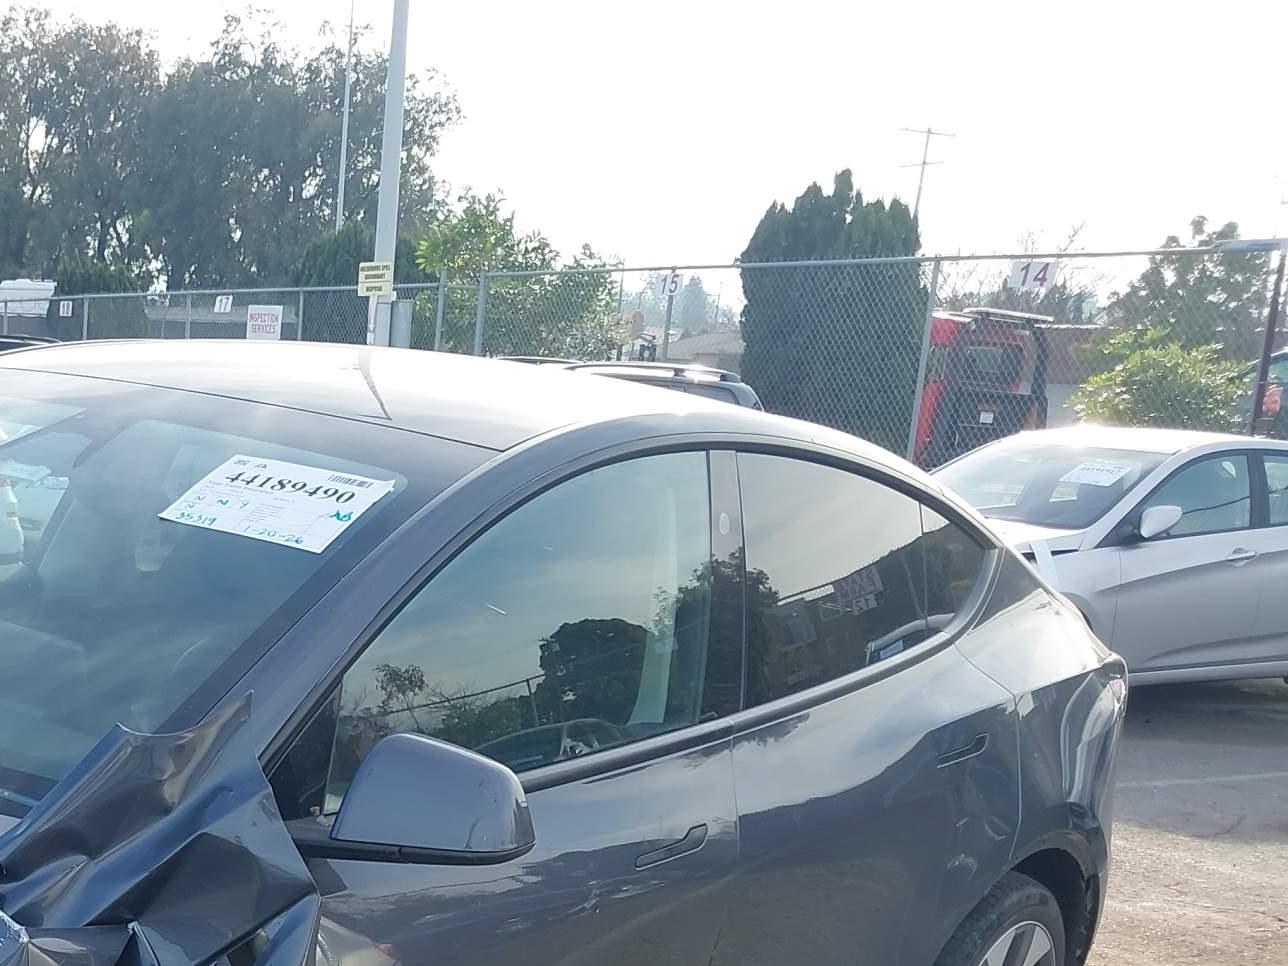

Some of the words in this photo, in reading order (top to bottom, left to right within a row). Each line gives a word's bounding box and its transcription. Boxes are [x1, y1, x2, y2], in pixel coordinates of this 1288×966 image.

[661, 274, 680, 294] 15
[1021, 262, 1050, 287] 14
[249, 313, 279, 323] INSPECTION
[251, 323, 276, 334] SERVICES
[225, 472, 356, 504] 44189490
